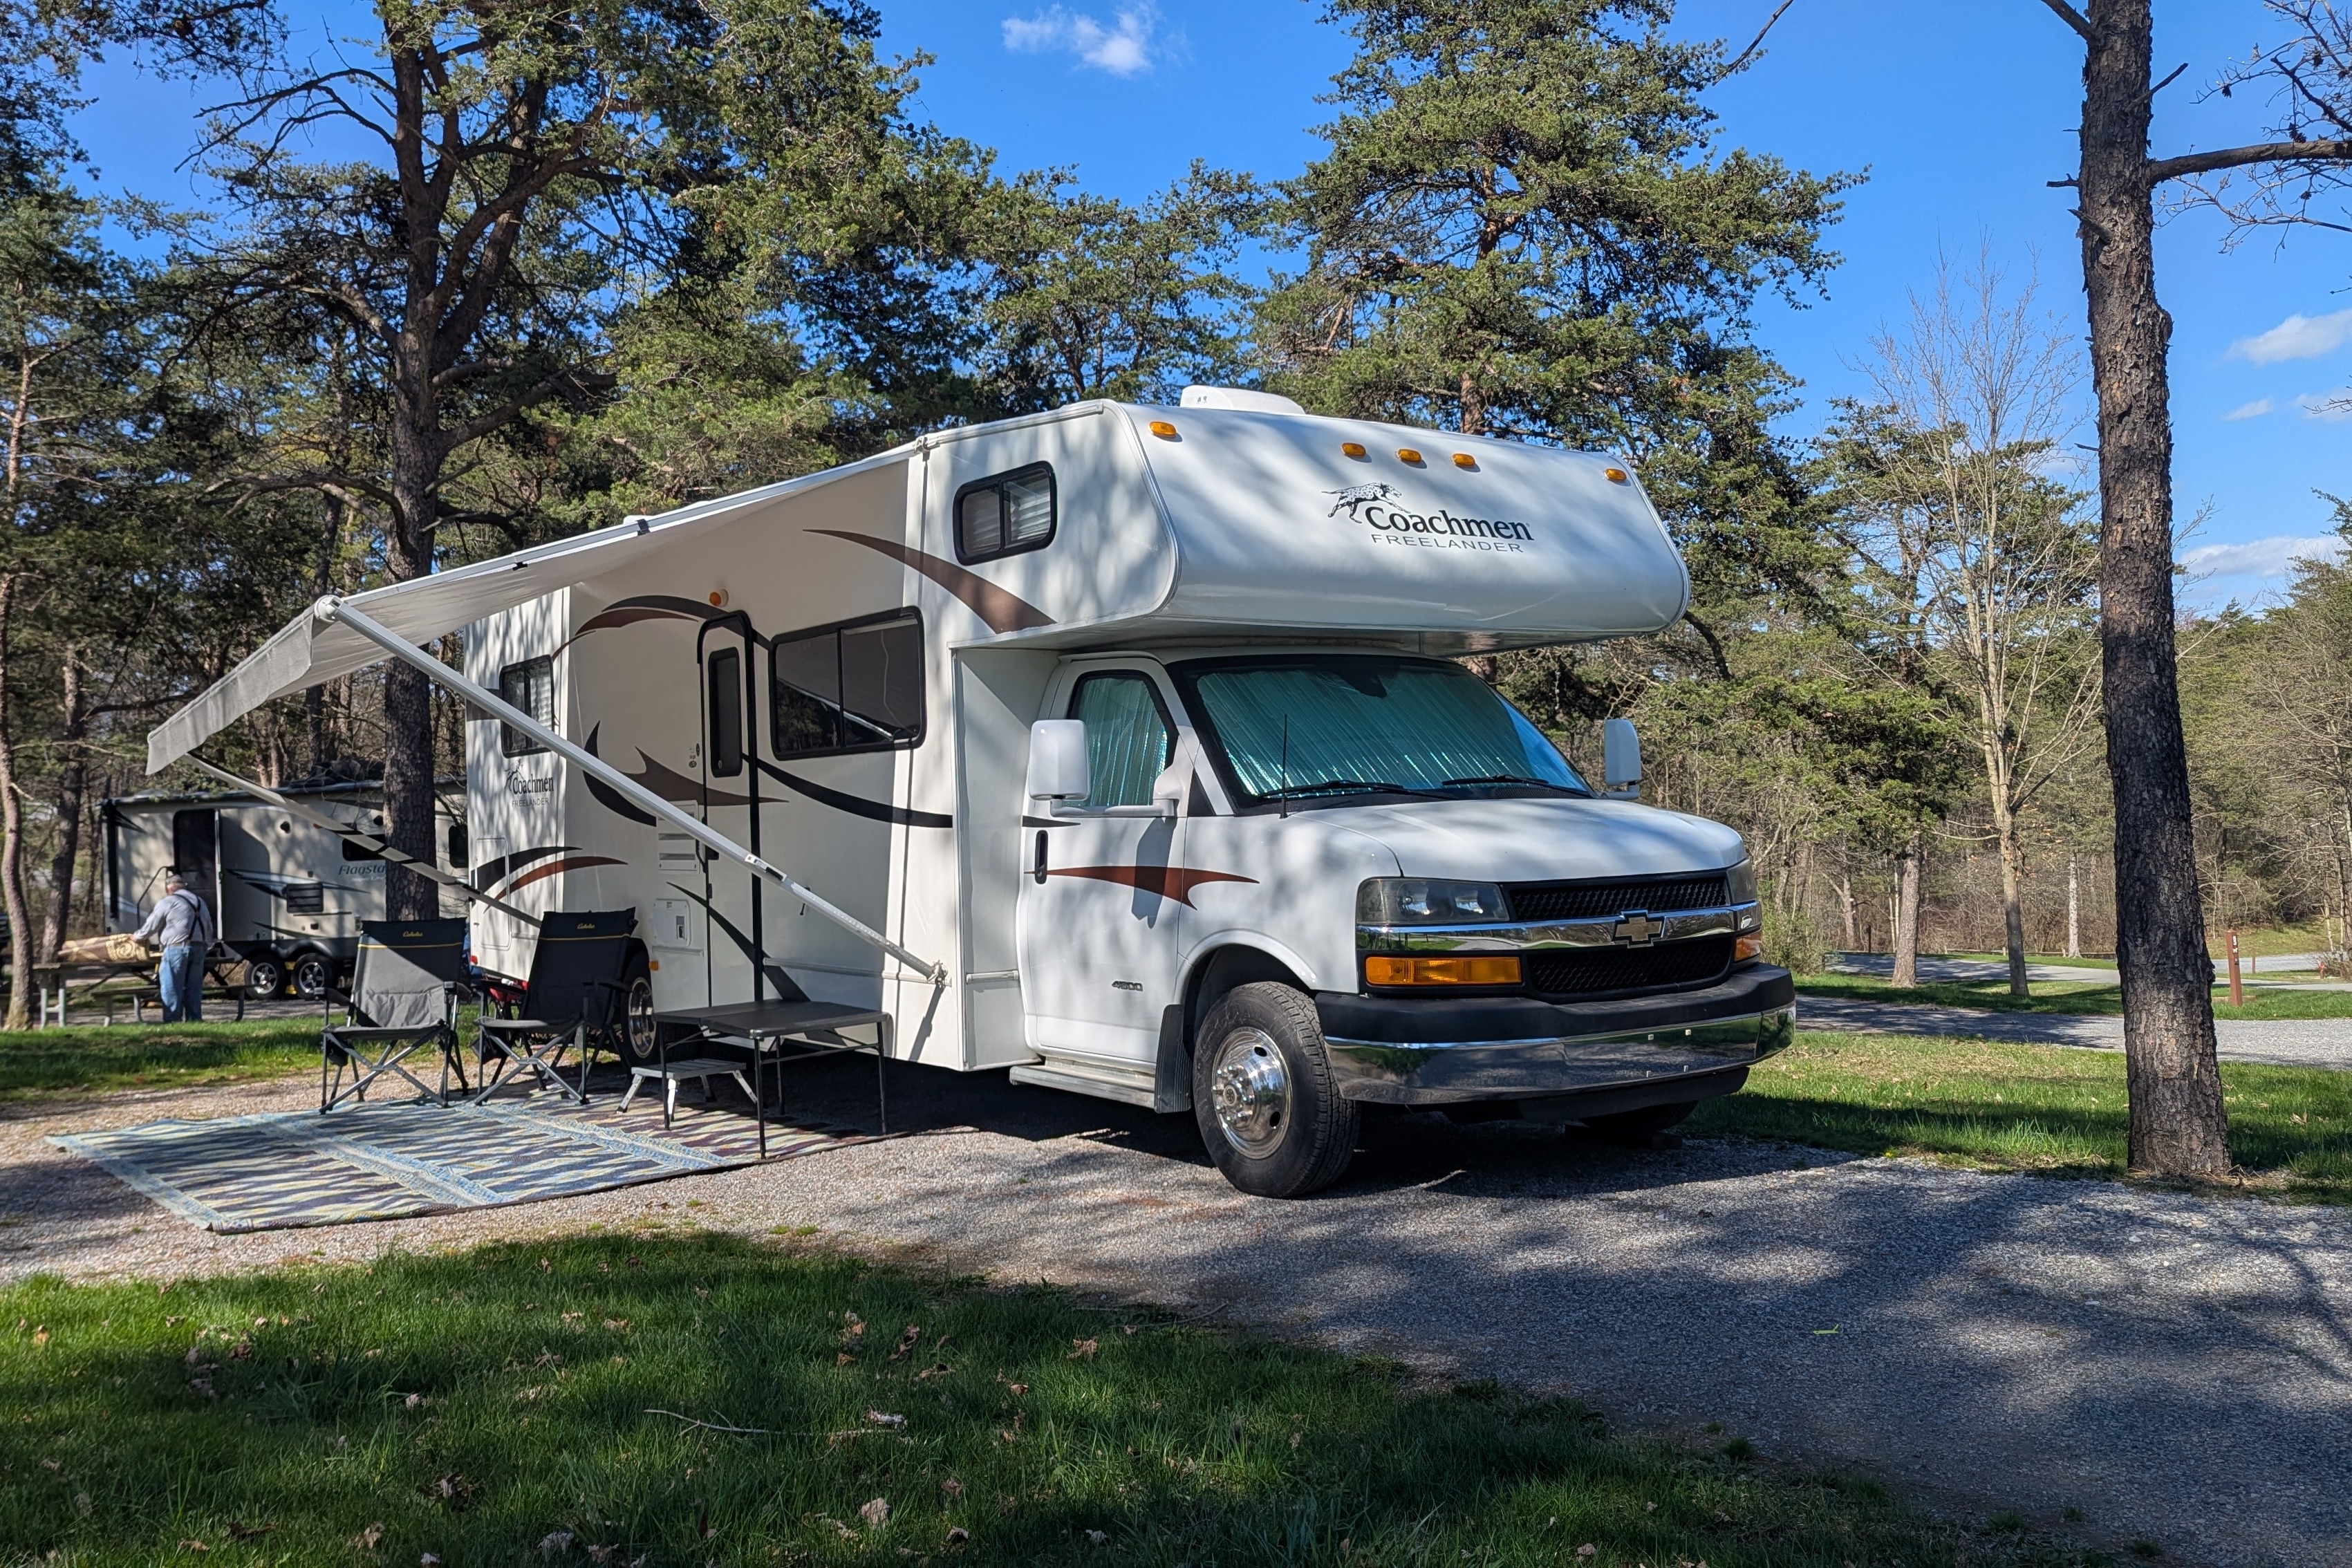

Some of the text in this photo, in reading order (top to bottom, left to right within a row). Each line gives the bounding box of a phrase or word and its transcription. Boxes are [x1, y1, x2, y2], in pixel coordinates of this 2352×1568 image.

[1365, 506, 1534, 541] Coachmen
[1371, 534, 1524, 553] FREELANDER
[512, 774, 554, 794] Coachmen
[512, 797, 550, 807] FREELANDER
[338, 864, 386, 875] Flagsta
